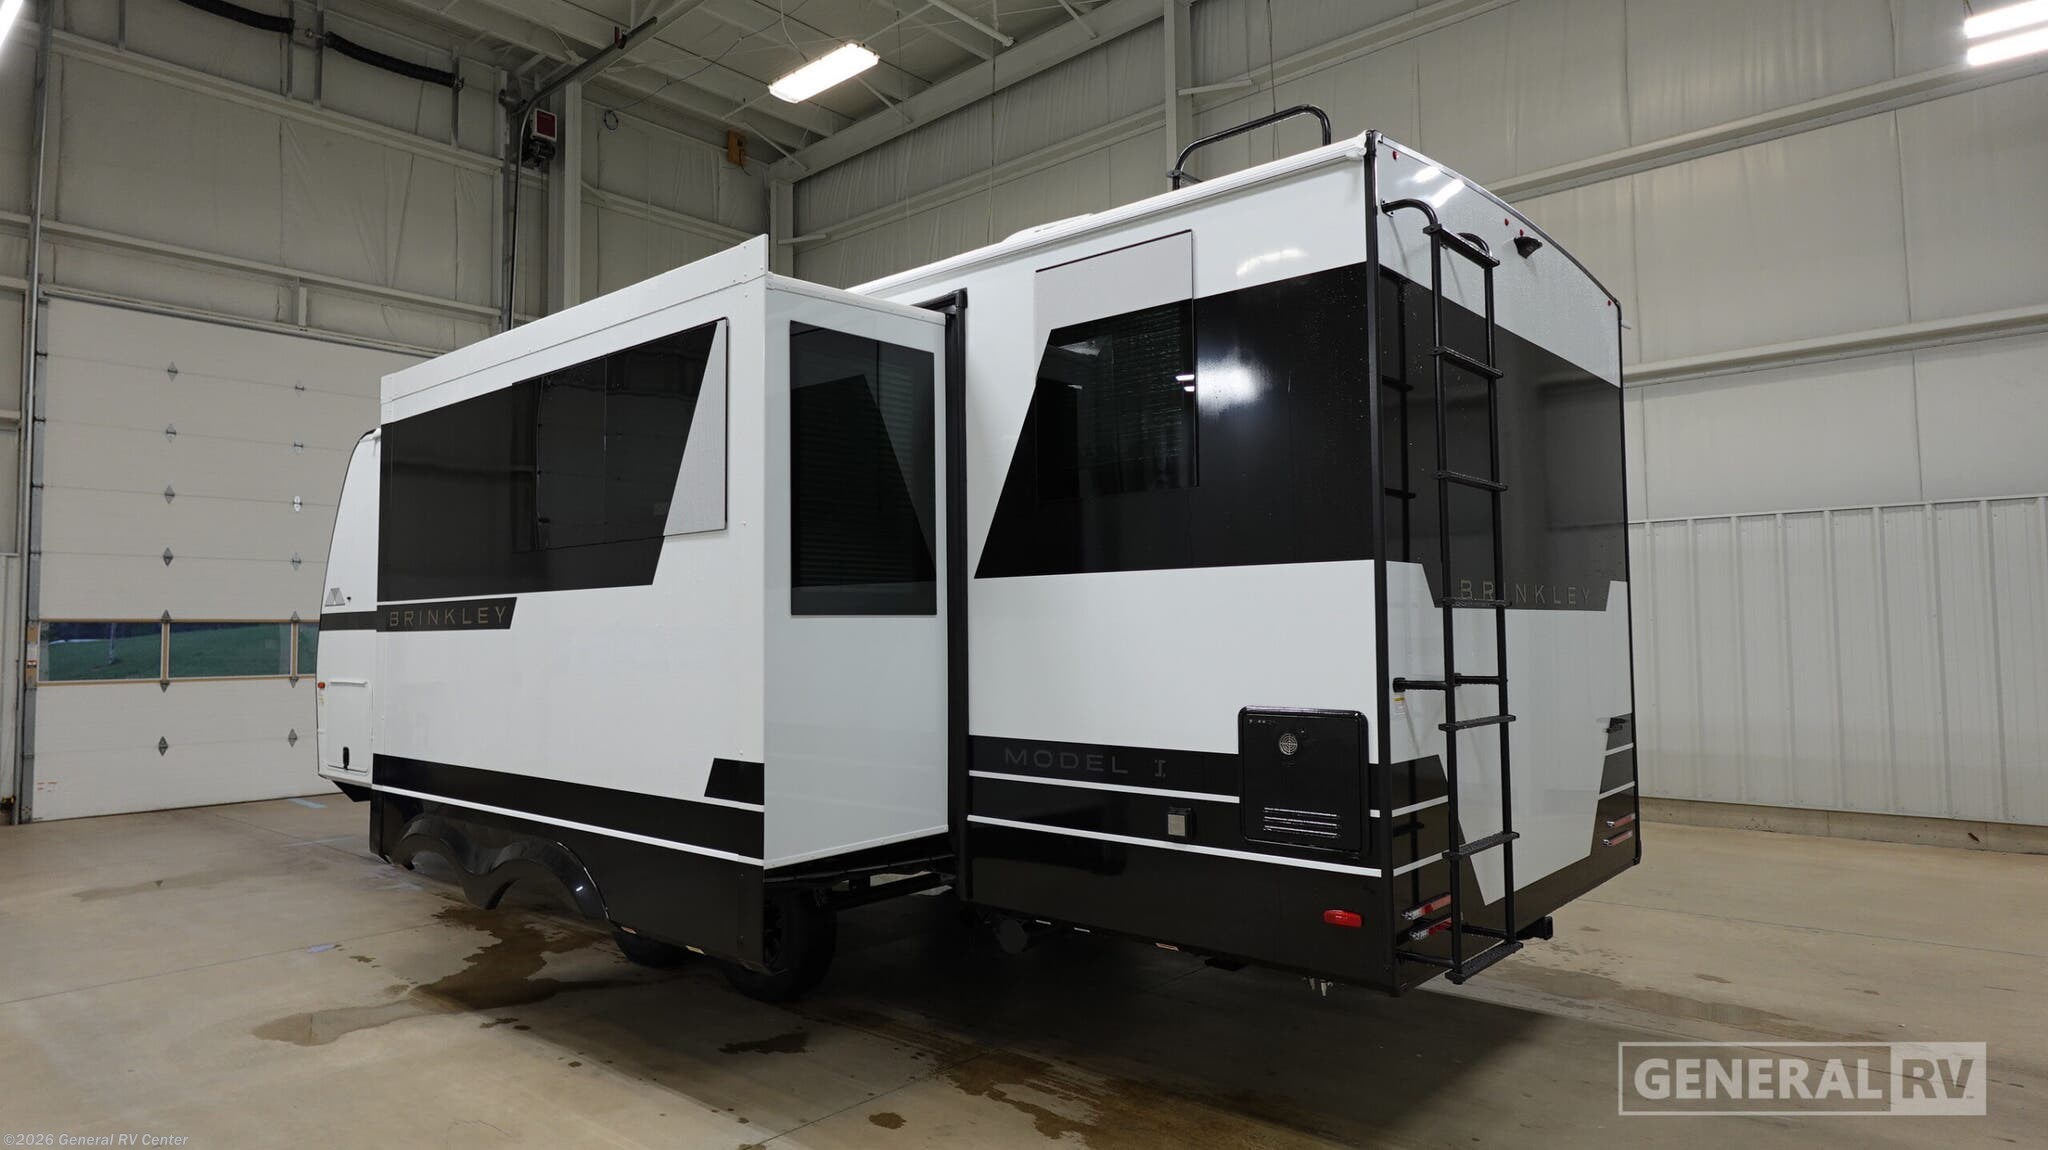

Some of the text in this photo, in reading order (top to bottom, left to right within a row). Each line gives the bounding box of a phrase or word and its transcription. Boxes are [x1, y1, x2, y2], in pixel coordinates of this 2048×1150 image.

[1460, 580, 1591, 604] BRINKLEY
[389, 606, 507, 627] BRINKLEY
[1004, 749, 1128, 773] MODEL
